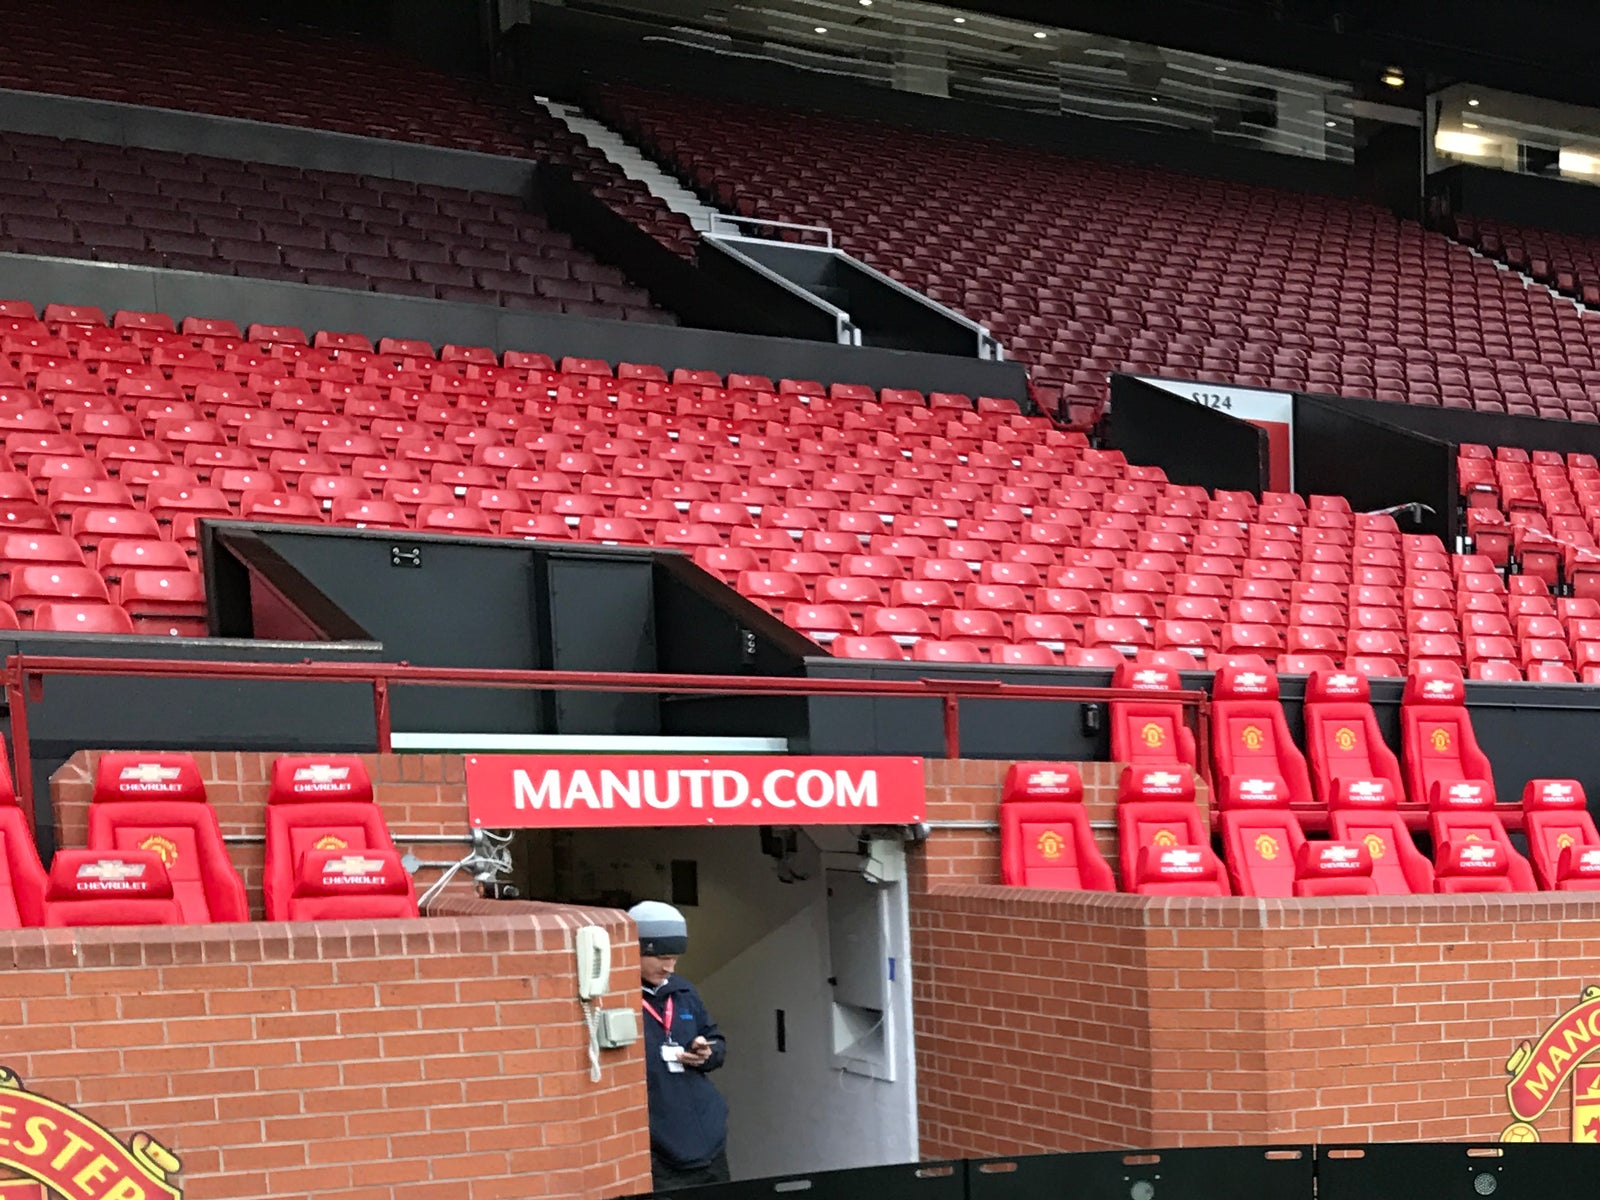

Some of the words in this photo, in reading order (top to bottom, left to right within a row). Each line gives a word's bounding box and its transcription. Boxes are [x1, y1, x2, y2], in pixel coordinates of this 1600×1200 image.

[119, 784, 182, 792] CHEVROLET
[294, 783, 351, 792] CHEVROLET
[513, 769, 878, 809] MANUTD.COM
[322, 876, 386, 885] CHEVROLET
[76, 881, 147, 891] CHEVROLET
